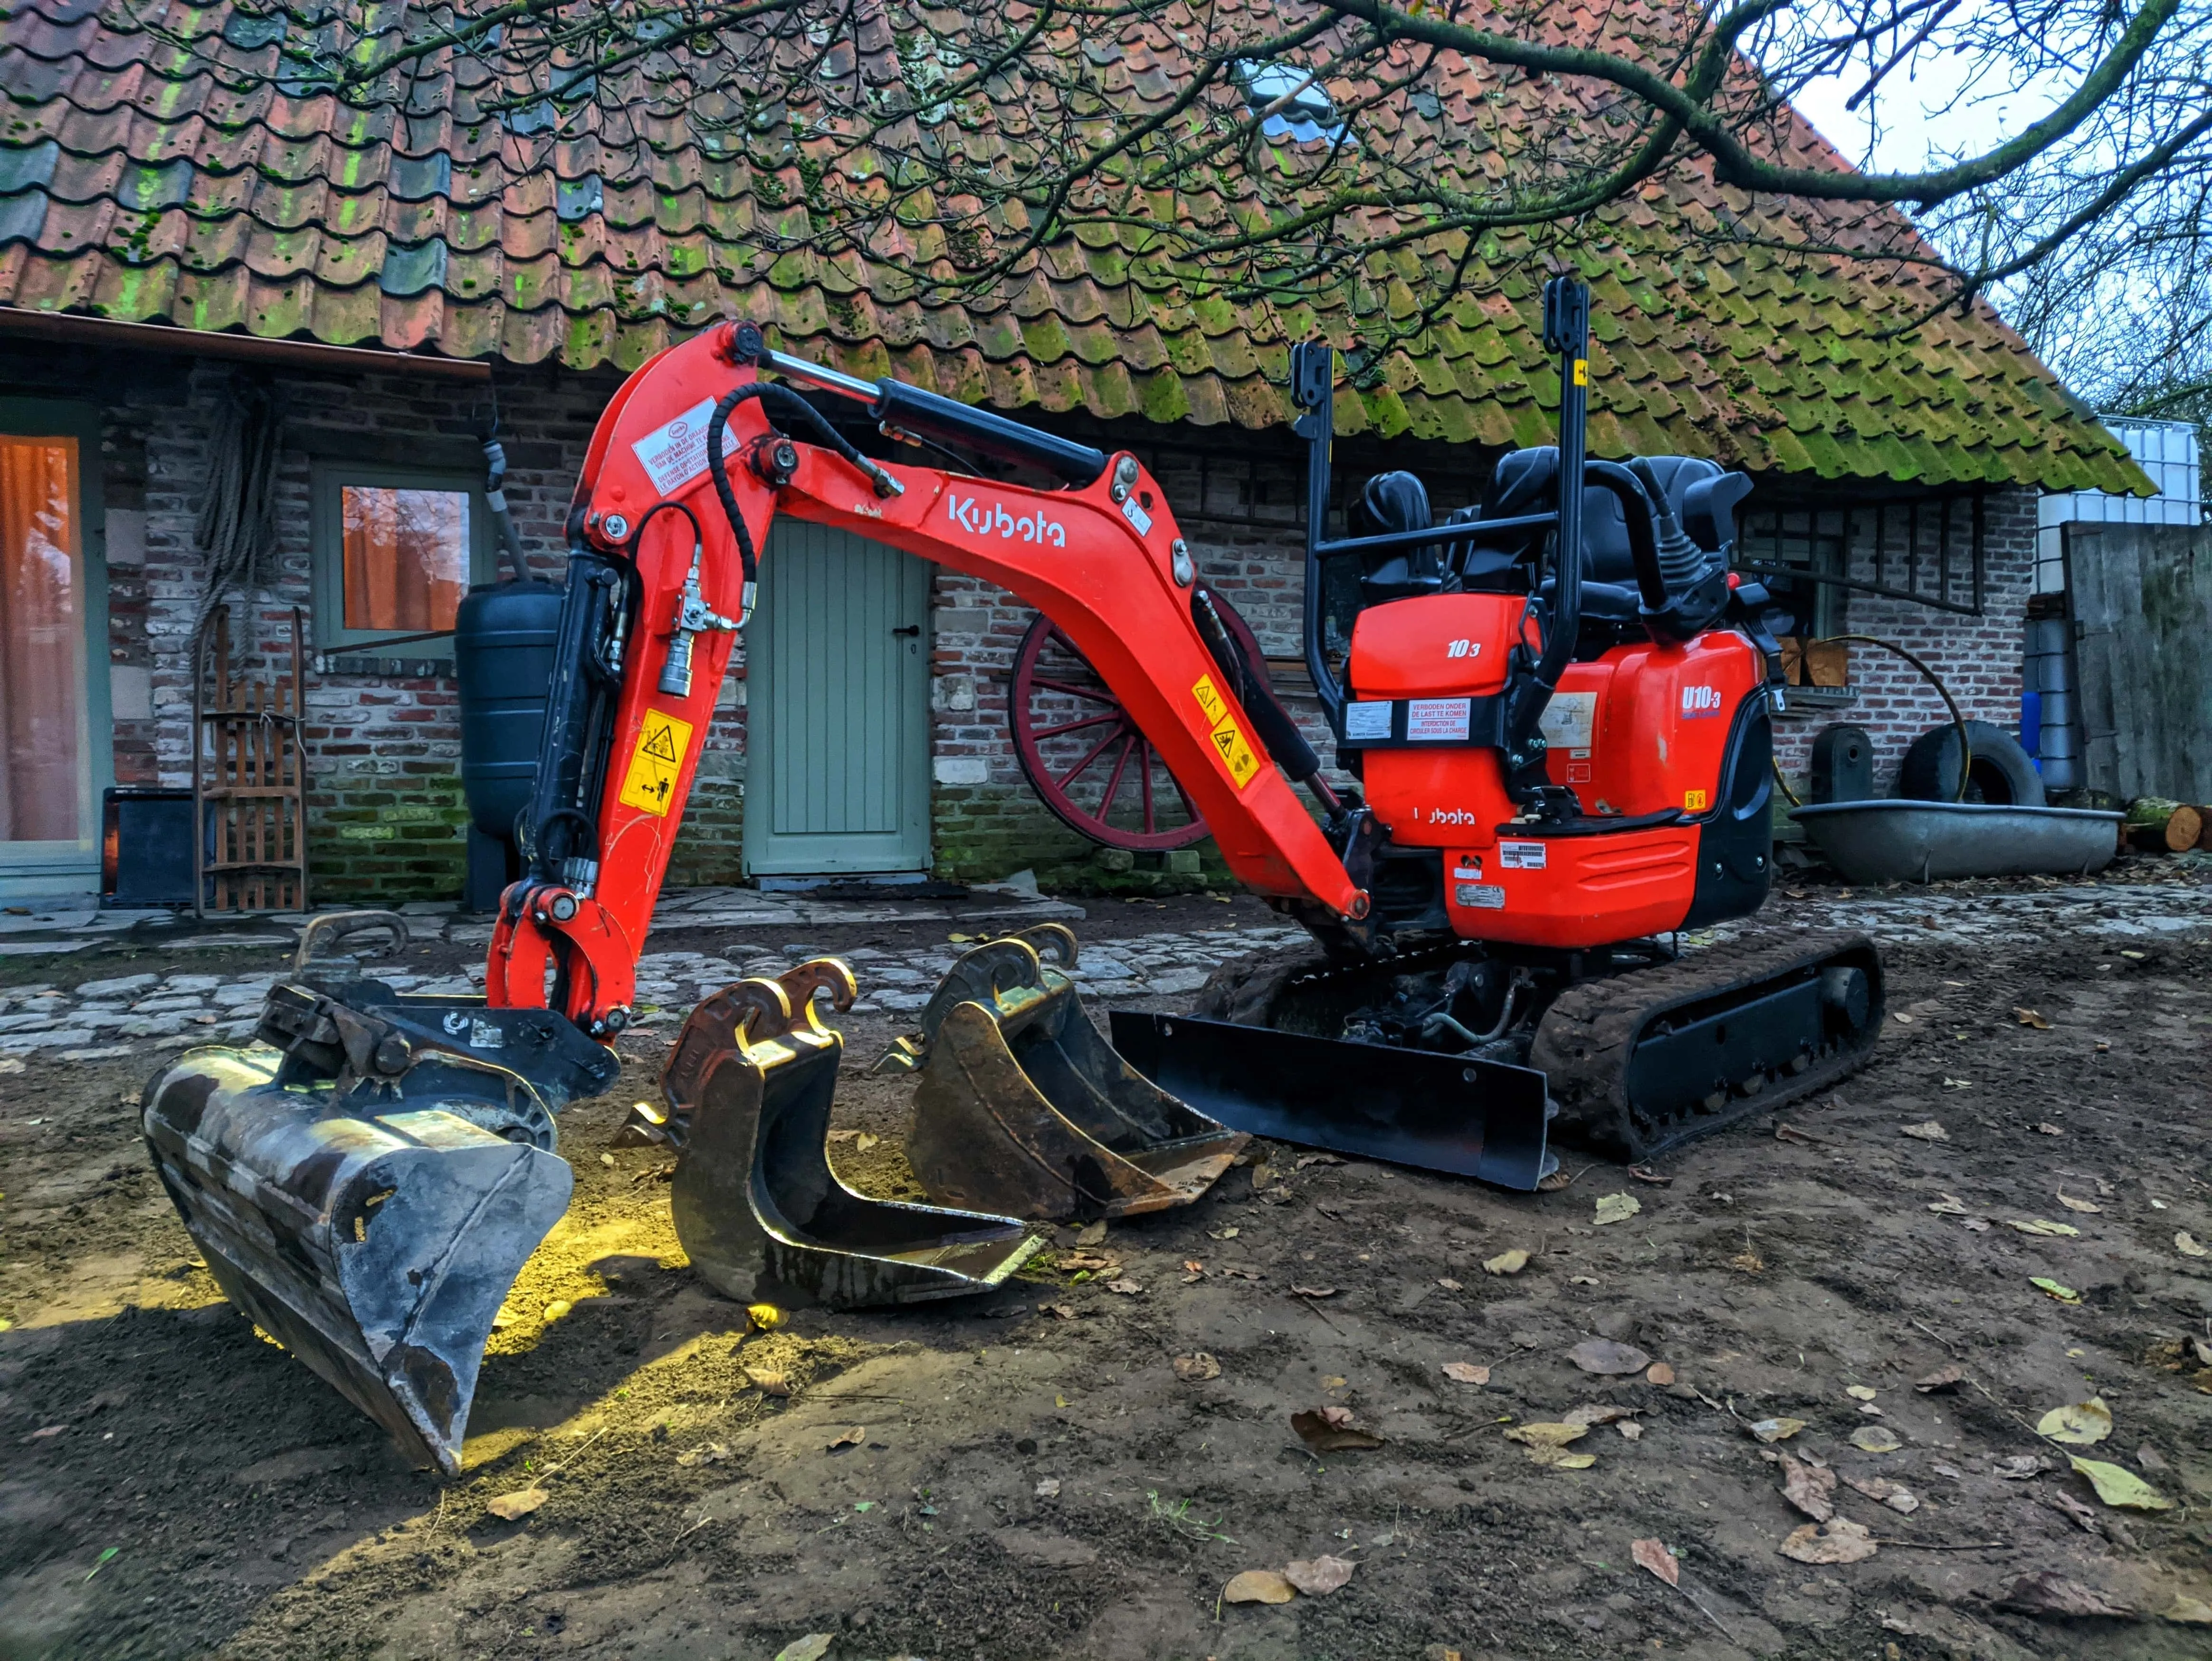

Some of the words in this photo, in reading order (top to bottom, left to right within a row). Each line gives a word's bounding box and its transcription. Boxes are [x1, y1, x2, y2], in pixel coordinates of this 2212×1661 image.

[675, 441, 681, 449] IN
[655, 459, 666, 469] VAN
[949, 494, 1065, 547] Kubota
[1682, 686, 1721, 709] U10-3
